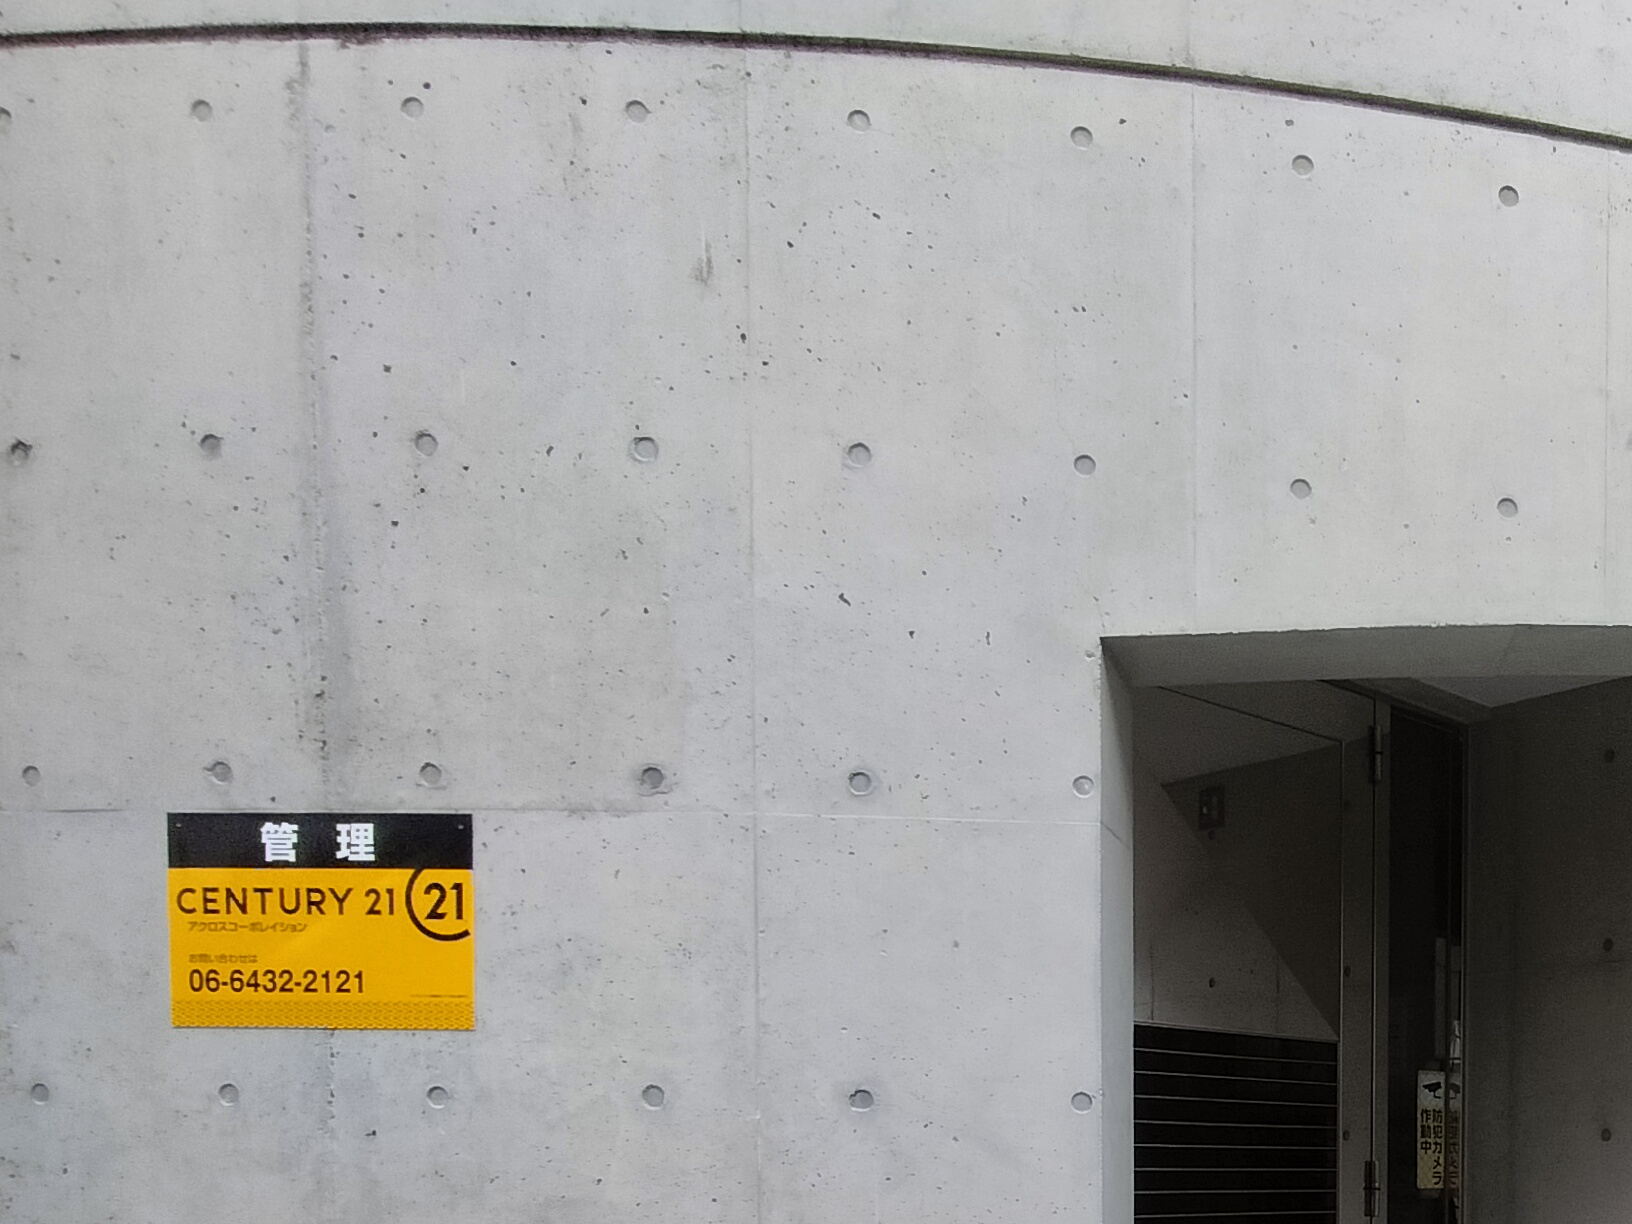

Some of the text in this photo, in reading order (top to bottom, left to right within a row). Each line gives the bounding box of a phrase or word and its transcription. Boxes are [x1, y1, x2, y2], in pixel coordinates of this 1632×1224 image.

[260, 822, 375, 862] 管理
[176, 887, 395, 916] CENTURY 21
[423, 883, 464, 920] 21
[188, 968, 365, 993] 06-6432-2121
[1420, 1108, 1431, 1154] 作動中
[1432, 1108, 1443, 1185] 防犯カメラ
